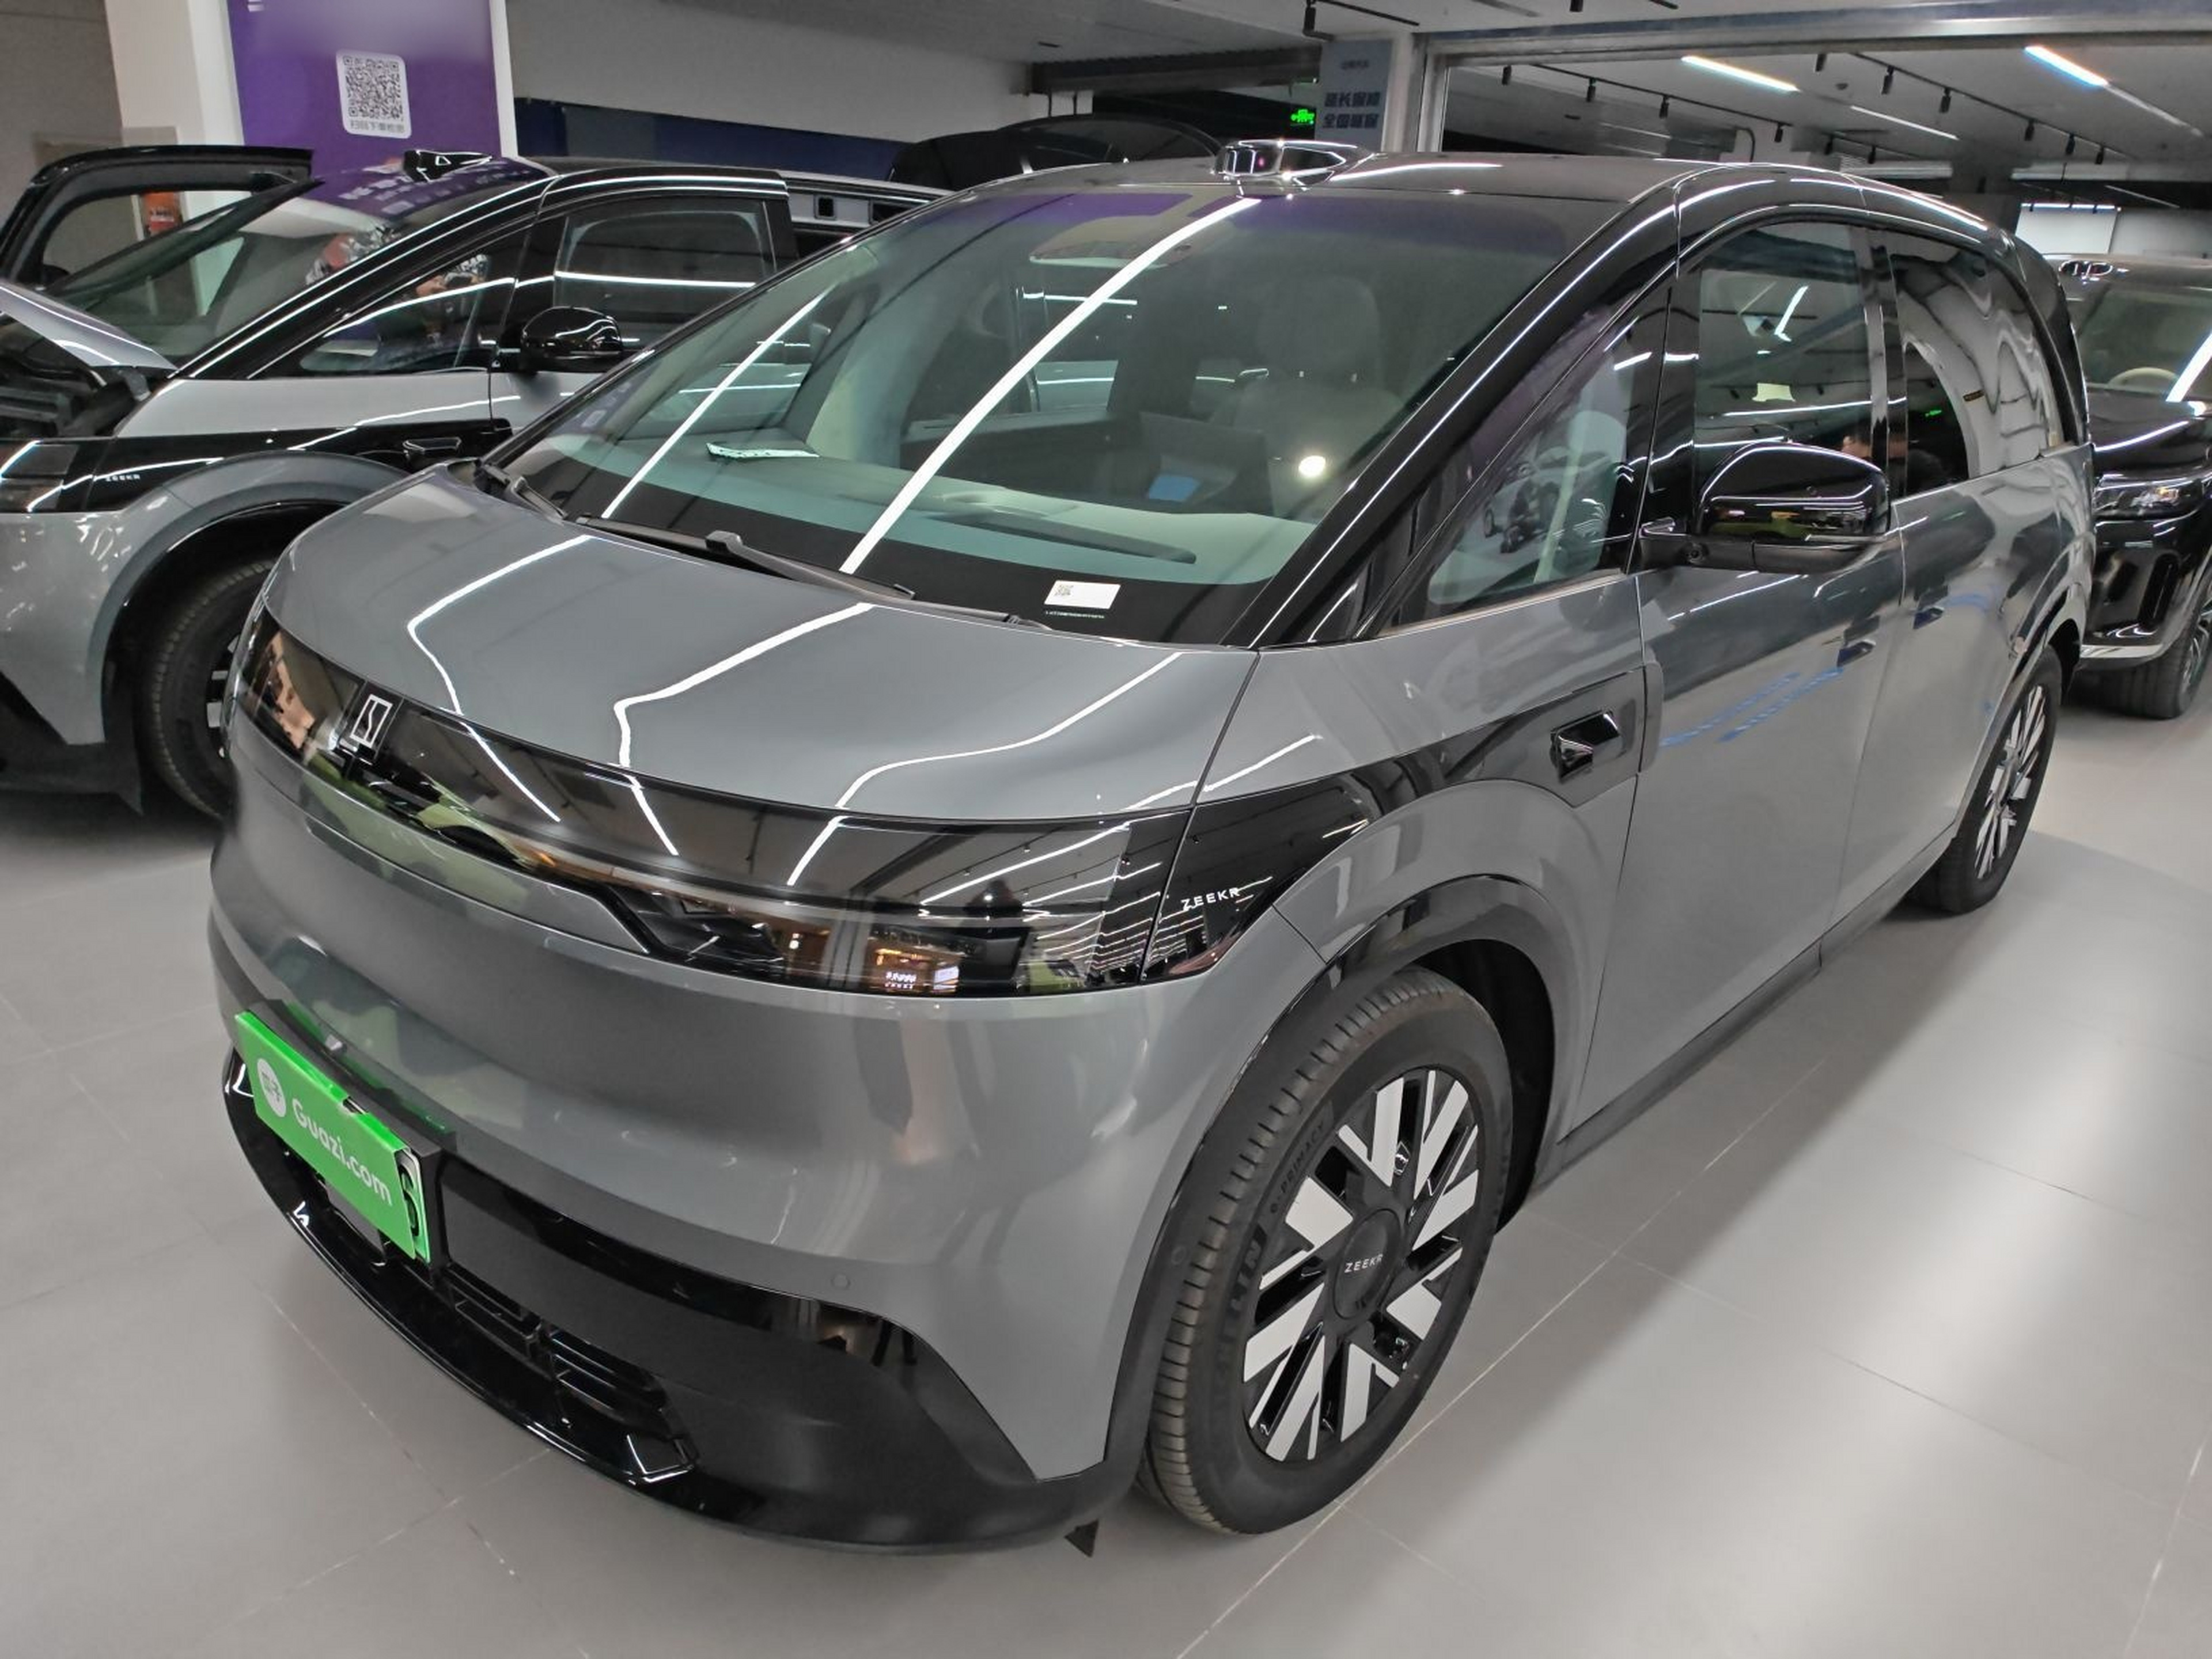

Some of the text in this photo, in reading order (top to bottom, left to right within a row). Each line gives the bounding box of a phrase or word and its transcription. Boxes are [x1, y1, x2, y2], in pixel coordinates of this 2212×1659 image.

[1180, 887, 1240, 911] ZEEKR
[292, 1098, 393, 1207] Guazi.com
[1344, 1253, 1383, 1273] ZEEKR
